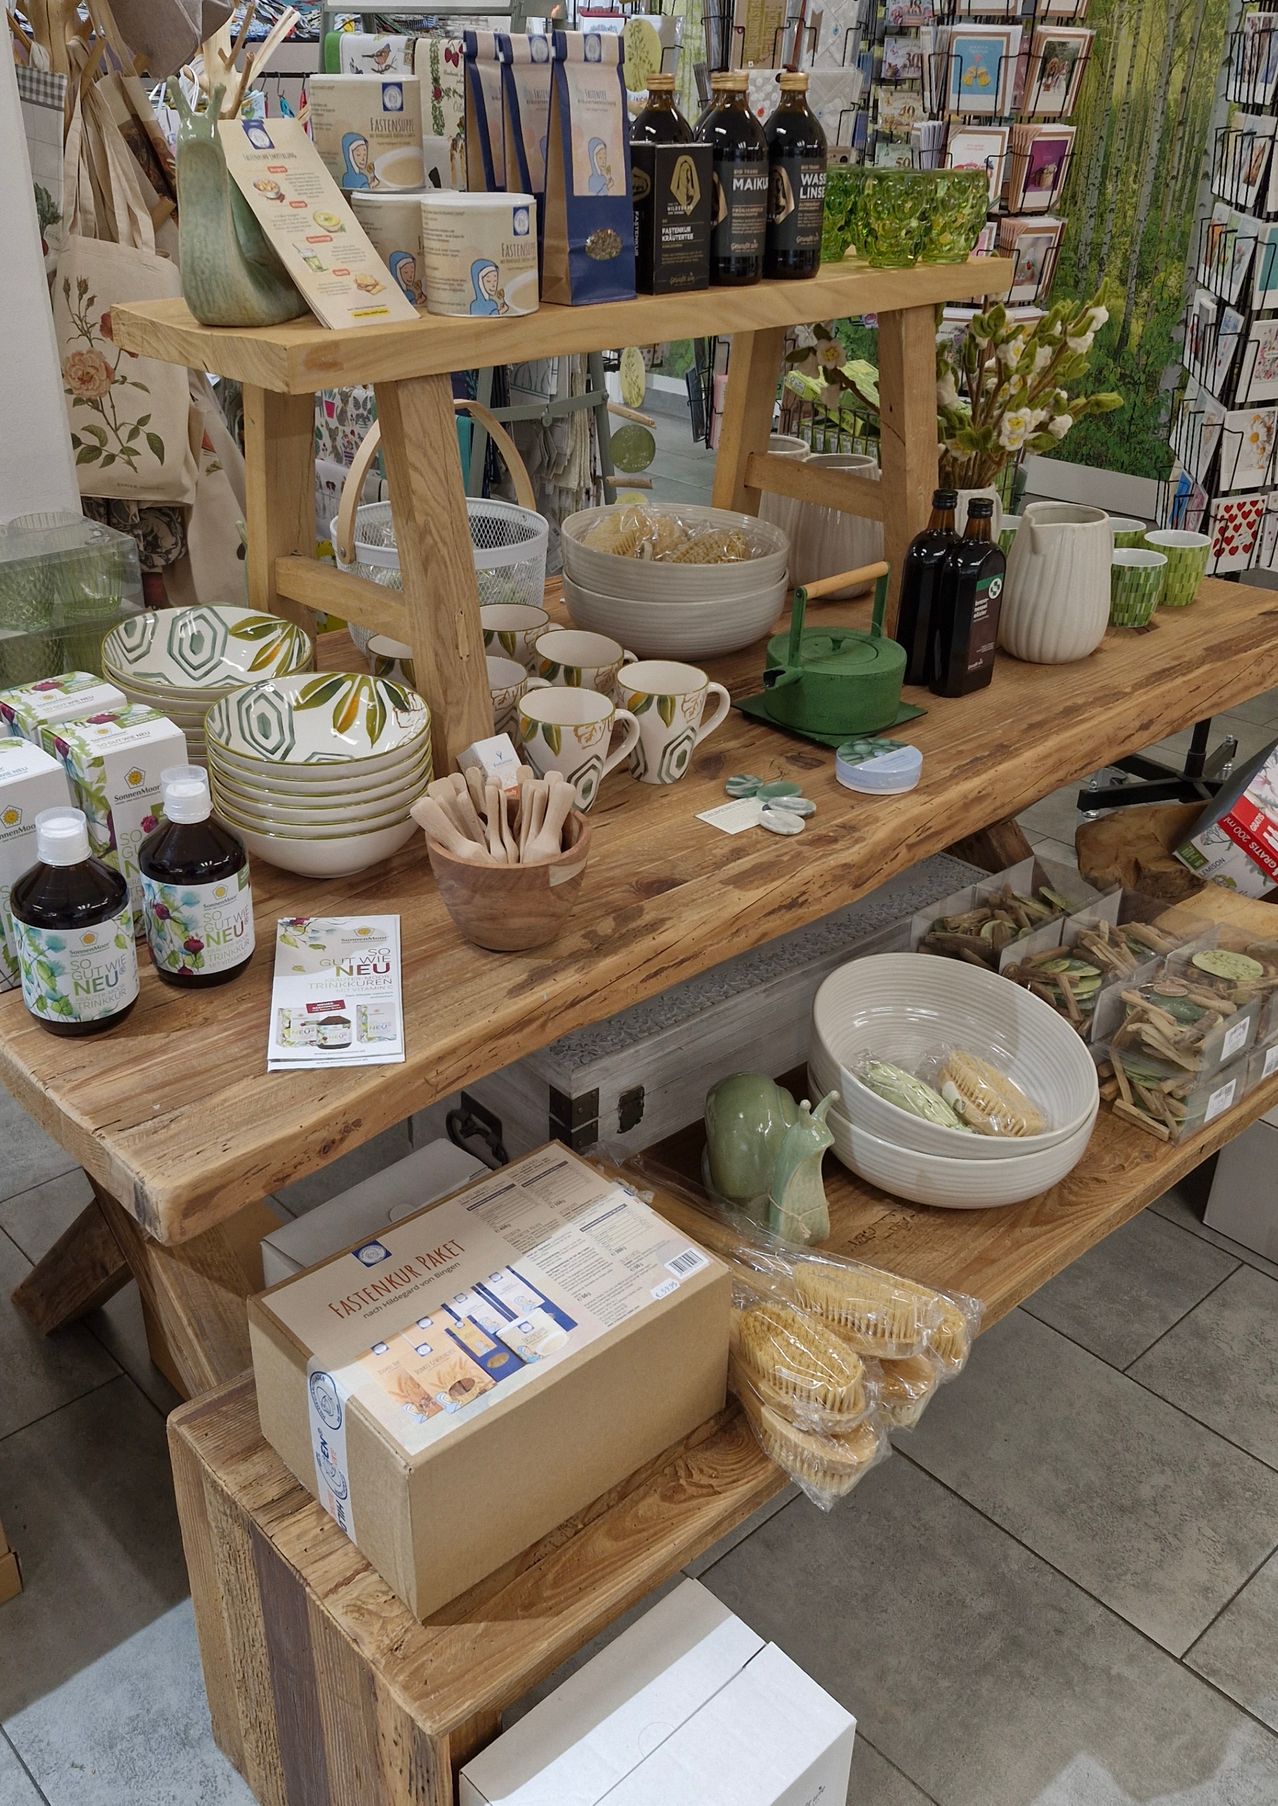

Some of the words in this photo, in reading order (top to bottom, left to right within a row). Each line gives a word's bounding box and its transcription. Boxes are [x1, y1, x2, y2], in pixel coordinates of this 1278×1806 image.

[905, 52, 921, 68] 30
[370, 117, 415, 132] FASTENSUPPE
[1224, 816, 1238, 828] ml
[120, 829, 143, 846] SO
[1233, 826, 1251, 842] 200
[1249, 841, 1278, 869] GRATIS
[203, 910, 222, 922] SO
[204, 917, 231, 933] GUT
[368, 948, 391, 956] SO
[70, 959, 91, 971] SO
[72, 965, 104, 980] GUT
[105, 953, 127, 973] WIE
[319, 957, 356, 967] GUT
[360, 955, 392, 964] WIE
[335, 962, 391, 977] NEU
[308, 978, 392, 990] TRINKKUREN
[328, 1264, 422, 1319] FASTENKUR
[416, 1239, 466, 1271] PAKET
[363, 1306, 383, 1319] nach
[383, 1284, 420, 1308] Hildegard
[421, 1277, 435, 1287] von
[434, 1262, 461, 1279] Bingen
